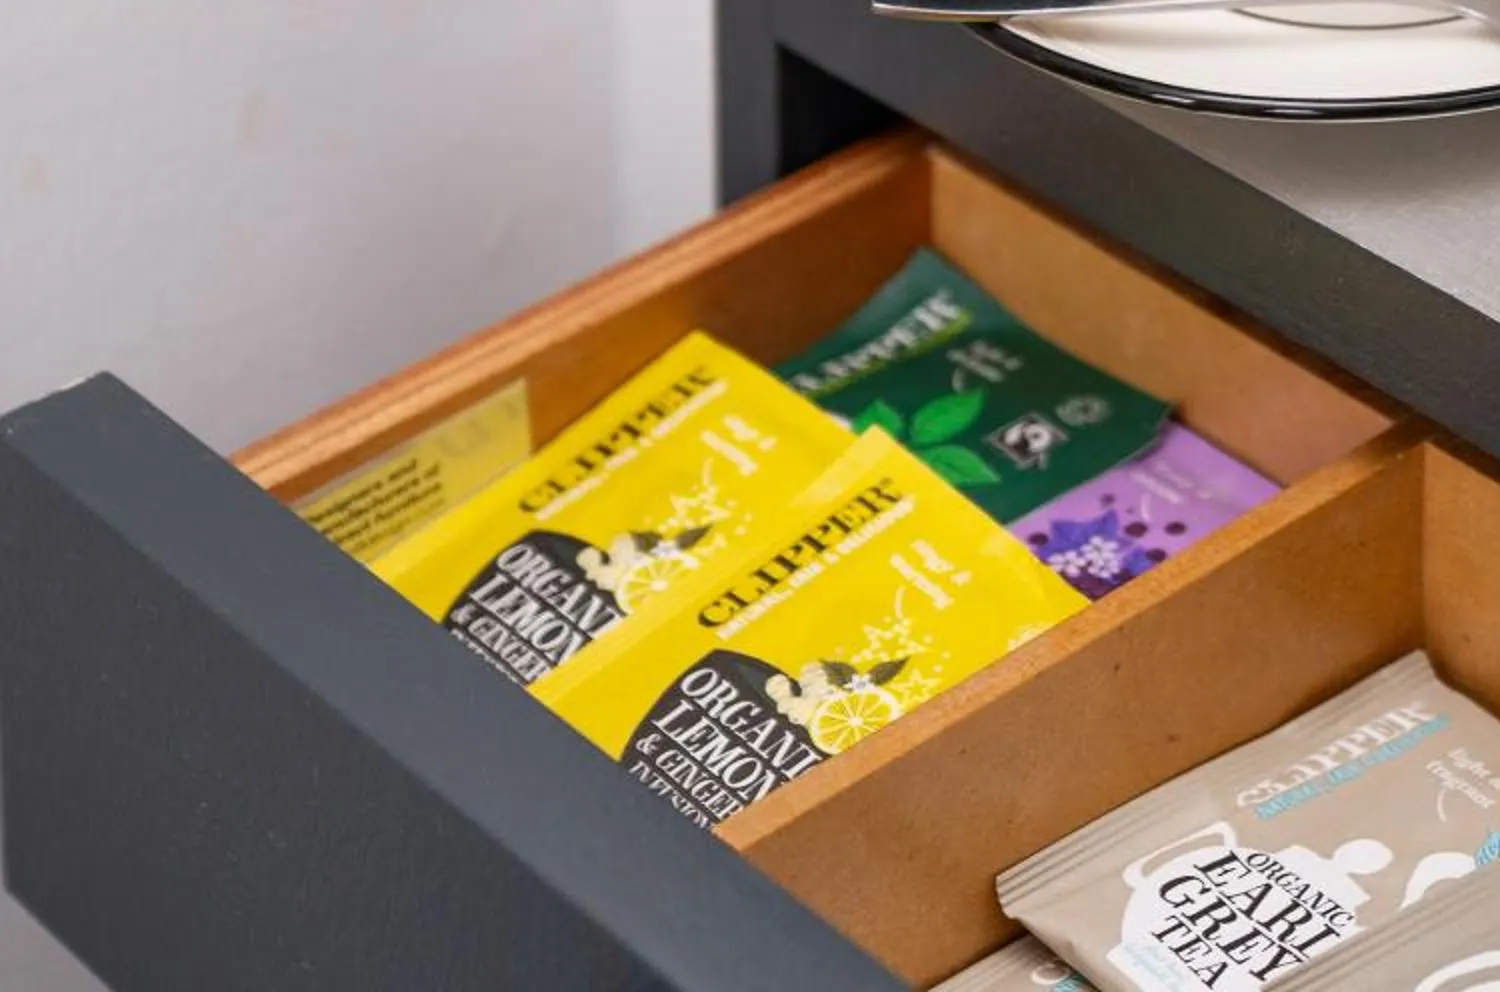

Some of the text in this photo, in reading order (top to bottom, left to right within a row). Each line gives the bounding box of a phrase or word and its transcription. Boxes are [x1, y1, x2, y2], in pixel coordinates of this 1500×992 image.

[789, 296, 961, 390] LIPPER
[519, 370, 716, 513] CLIPPER
[497, 543, 623, 640] ORGANI
[698, 483, 902, 627] CLIPPER
[636, 733, 662, 755] &
[681, 667, 823, 780] ORGANI
[1236, 704, 1438, 808] CLIPPER
[1159, 874, 1304, 982] GREY
[1247, 852, 1354, 928] ORGANIC
[1152, 915, 1229, 990] TEA
